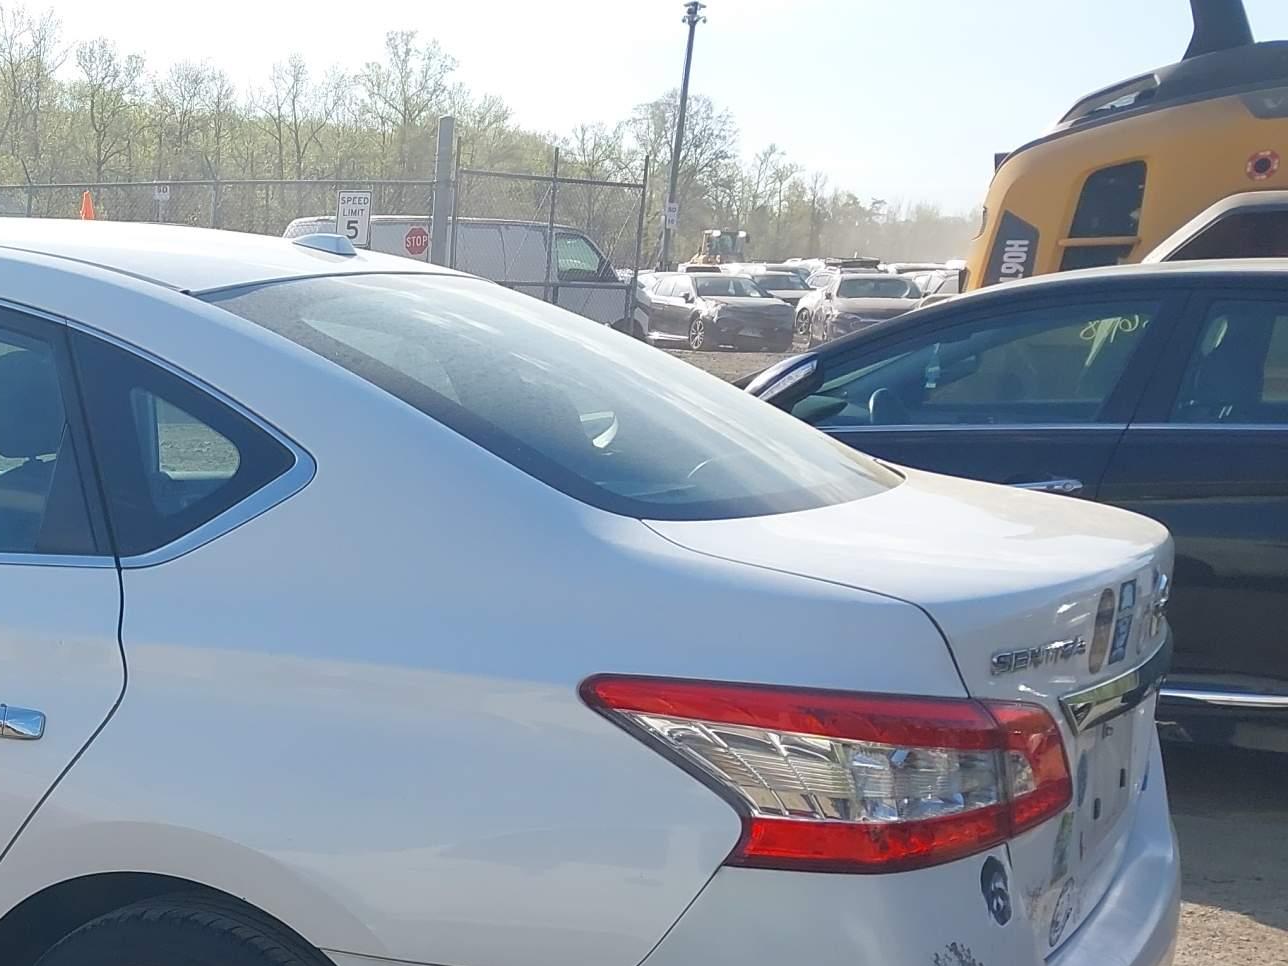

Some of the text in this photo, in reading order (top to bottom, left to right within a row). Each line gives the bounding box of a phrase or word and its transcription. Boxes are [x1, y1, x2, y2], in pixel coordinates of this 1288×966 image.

[340, 196, 369, 206] SPEED
[342, 208, 365, 217] LIMIT
[346, 220, 359, 240] 5
[406, 235, 428, 248] STOP
